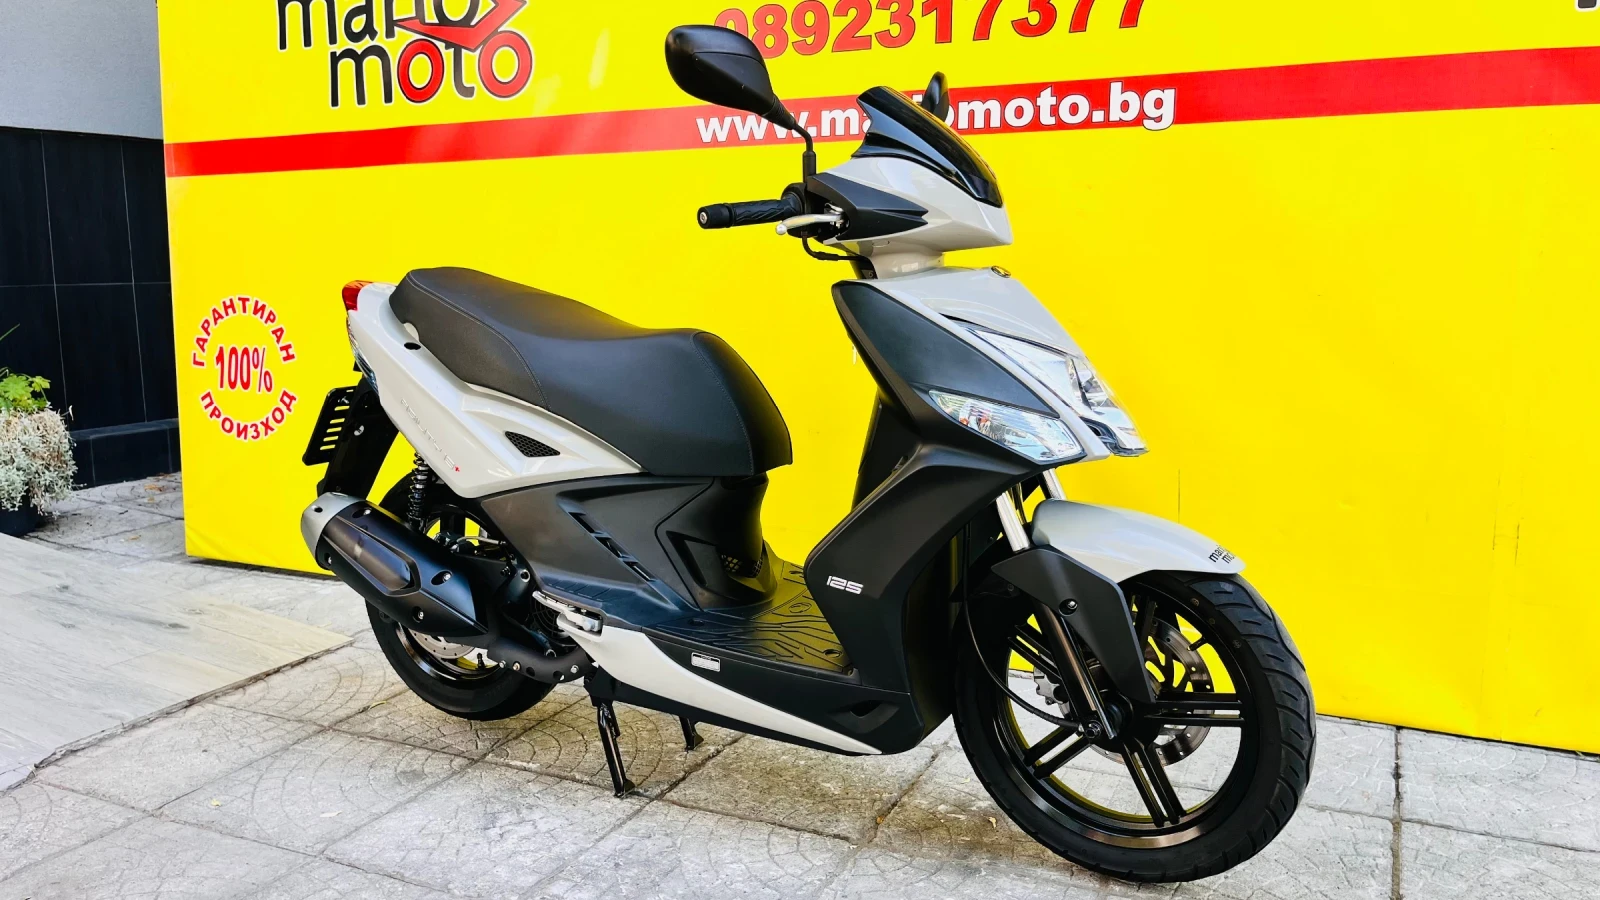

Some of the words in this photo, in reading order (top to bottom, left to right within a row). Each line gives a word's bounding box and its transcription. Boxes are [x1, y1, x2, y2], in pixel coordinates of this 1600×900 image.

[330, 30, 533, 108] moto
[192, 297, 296, 367] ГАРАНТИРАН
[215, 346, 273, 392] 100%
[200, 390, 297, 440] ПРОИЗХОД
[826, 575, 864, 595] 125
